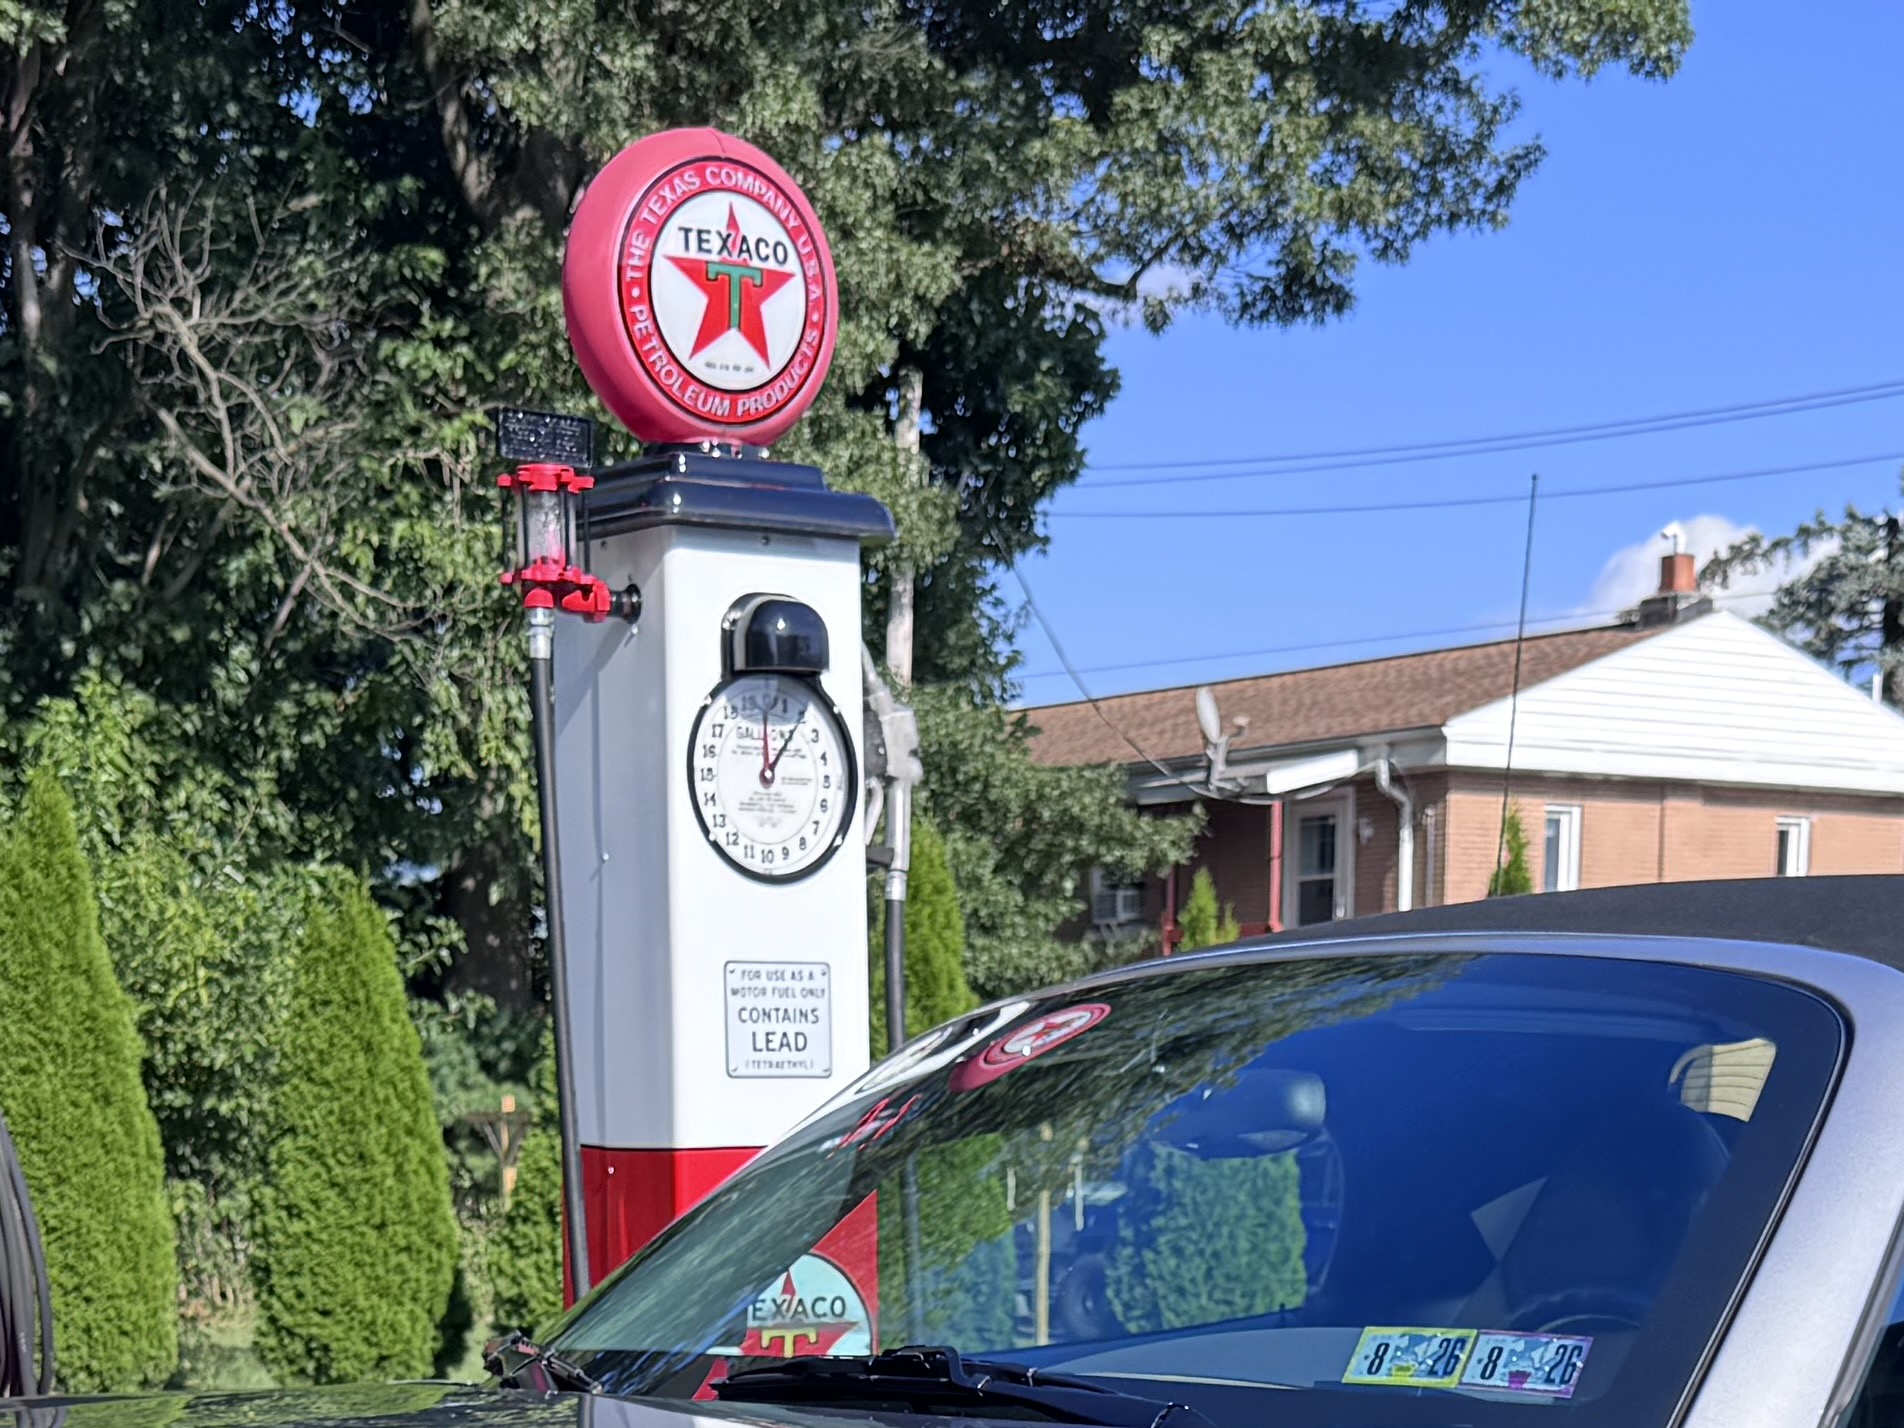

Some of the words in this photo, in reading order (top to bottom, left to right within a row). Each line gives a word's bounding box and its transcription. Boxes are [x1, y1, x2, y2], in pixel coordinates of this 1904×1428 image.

[625, 231, 650, 283] THE
[643, 170, 701, 227] TEXAS
[705, 165, 801, 229] COMPANY
[678, 226, 789, 268] TEXACO
[629, 305, 730, 417] PETROLEUM
[736, 328, 817, 417] PRODUCTS
[712, 724, 724, 738] 17
[704, 792, 717, 807] 14
[713, 814, 727, 828] 13
[812, 821, 820, 835] 7
[726, 832, 739, 846] 12
[799, 836, 807, 850] 8
[744, 845, 755, 859] 11
[761, 849, 775, 864] 10
[781, 846, 790, 860] 9
[741, 970, 761, 981] FOR
[766, 970, 786, 982] USE
[791, 970, 803, 982] AS
[808, 970, 814, 981] A
[731, 987, 767, 998] MOTOR
[772, 987, 796, 999] FUEL
[800, 987, 826, 999] ONLY
[738, 1006, 820, 1024] CONTAINS
[751, 1031, 808, 1052] LEAD
[751, 1295, 847, 1321] EXACO
[1366, 1341, 1390, 1375] 8
[1429, 1337, 1467, 1377] 26
[1479, 1346, 1504, 1380] 8
[1545, 1343, 1584, 1385] 26
